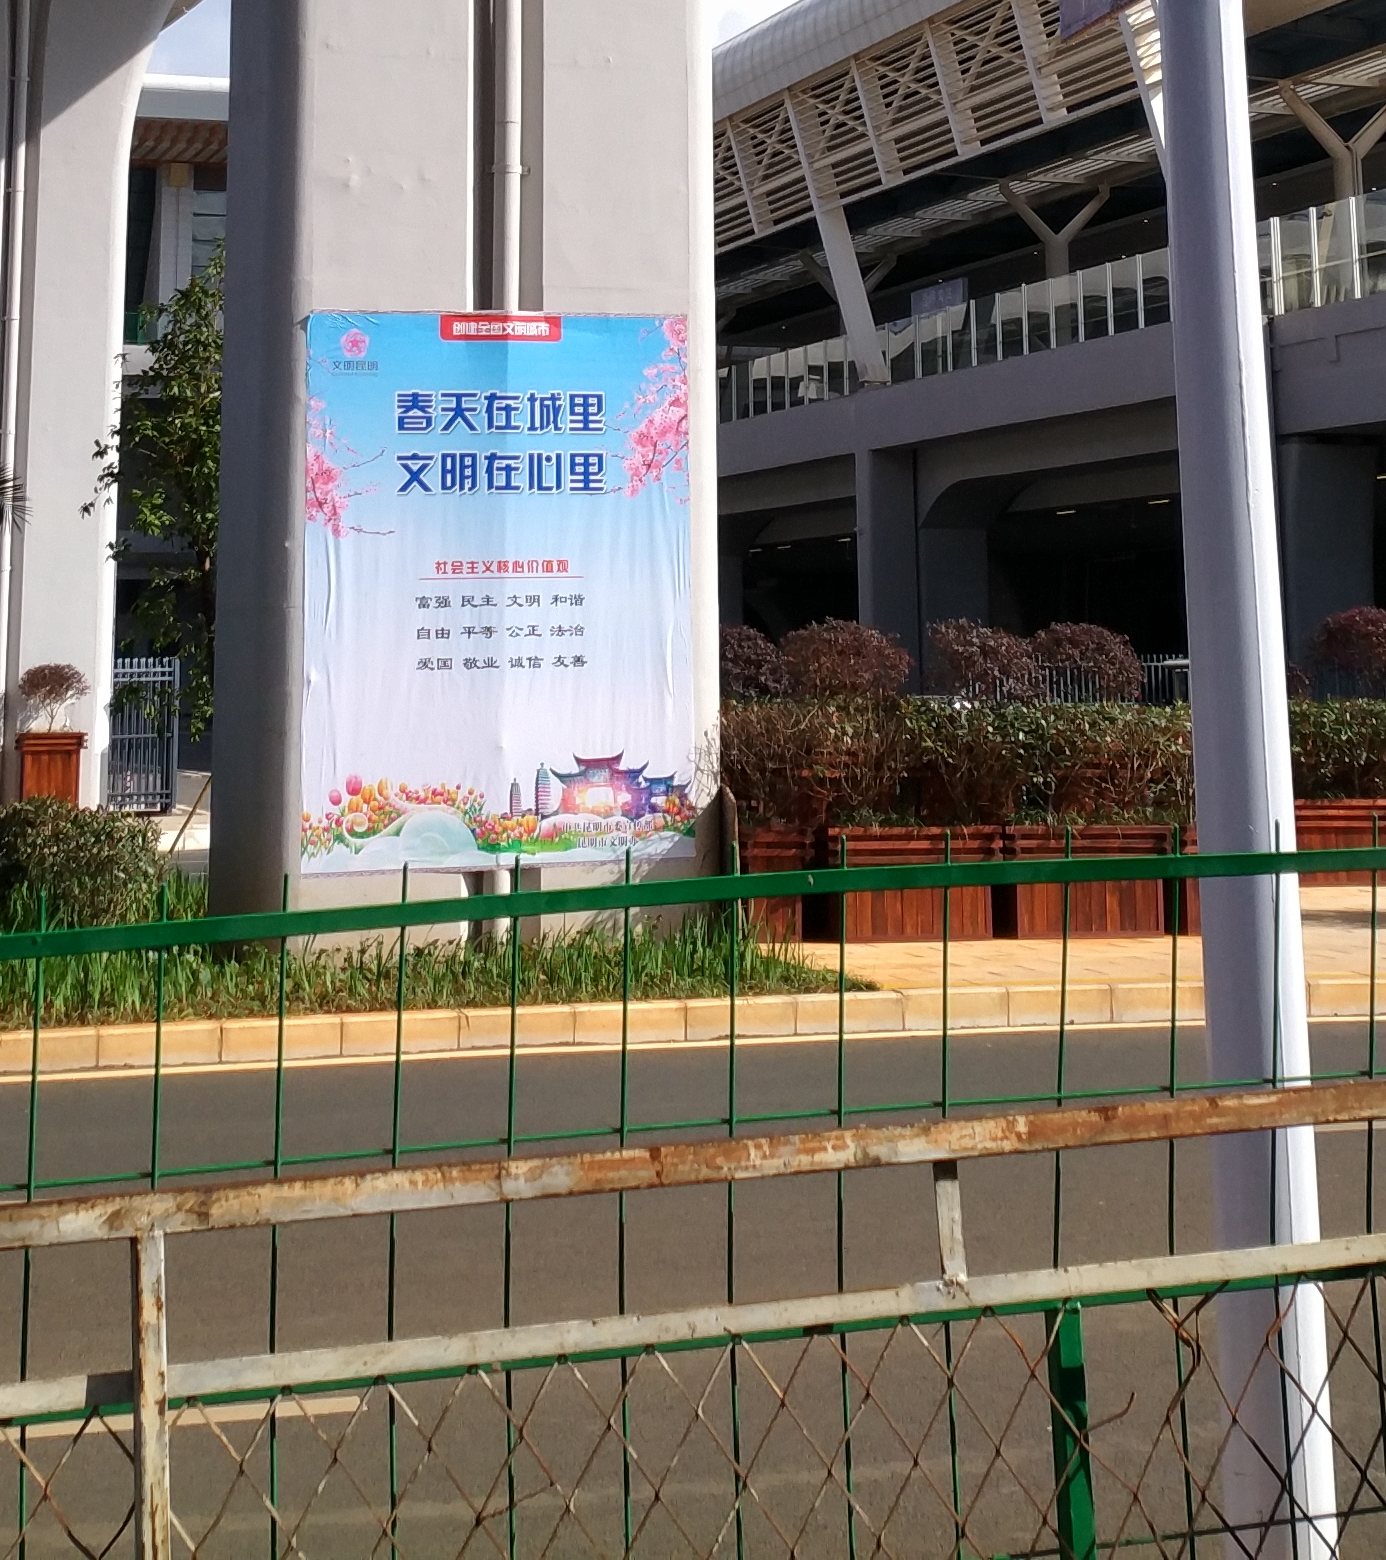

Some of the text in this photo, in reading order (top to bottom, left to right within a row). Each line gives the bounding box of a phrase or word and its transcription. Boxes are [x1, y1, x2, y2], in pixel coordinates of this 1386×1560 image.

[453, 322, 549, 336] 创建全国文明城市
[333, 361, 378, 371] 文明昆明
[396, 391, 605, 433] 春天在城里
[396, 452, 606, 494] 文明在心里
[435, 560, 569, 574] 社会主义核心价值观
[415, 594, 585, 609] 富强 民主 文明 和谐
[417, 624, 585, 640] 自由 平等 公正 法治
[416, 655, 588, 671] 爱国 敬业 诚信 友善
